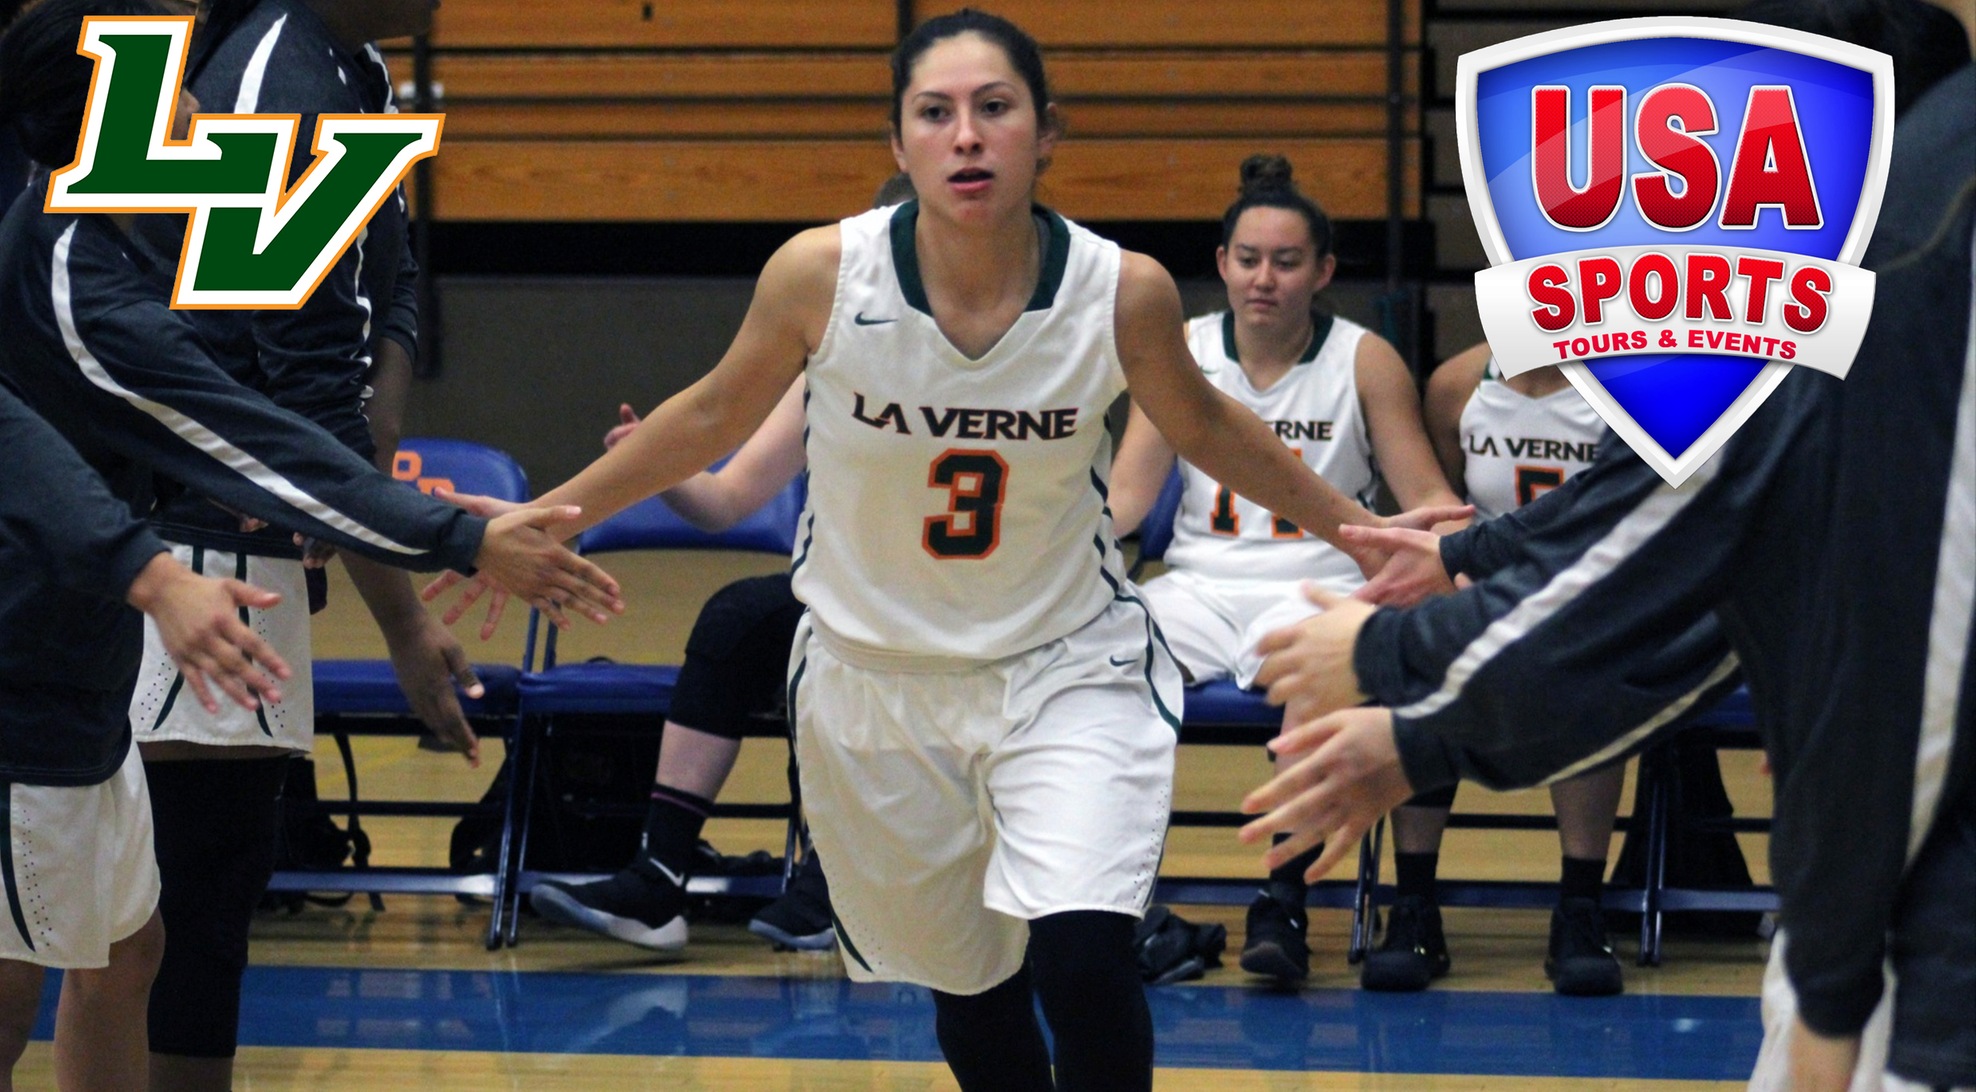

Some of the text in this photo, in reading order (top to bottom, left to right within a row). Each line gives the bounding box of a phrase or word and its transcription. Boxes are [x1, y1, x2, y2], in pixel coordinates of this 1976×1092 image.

[851, 391, 1080, 441] LA VERNE
[1263, 420, 1334, 441] RNE
[1469, 434, 1601, 463] LA VERNE
[921, 448, 1010, 560] 3
